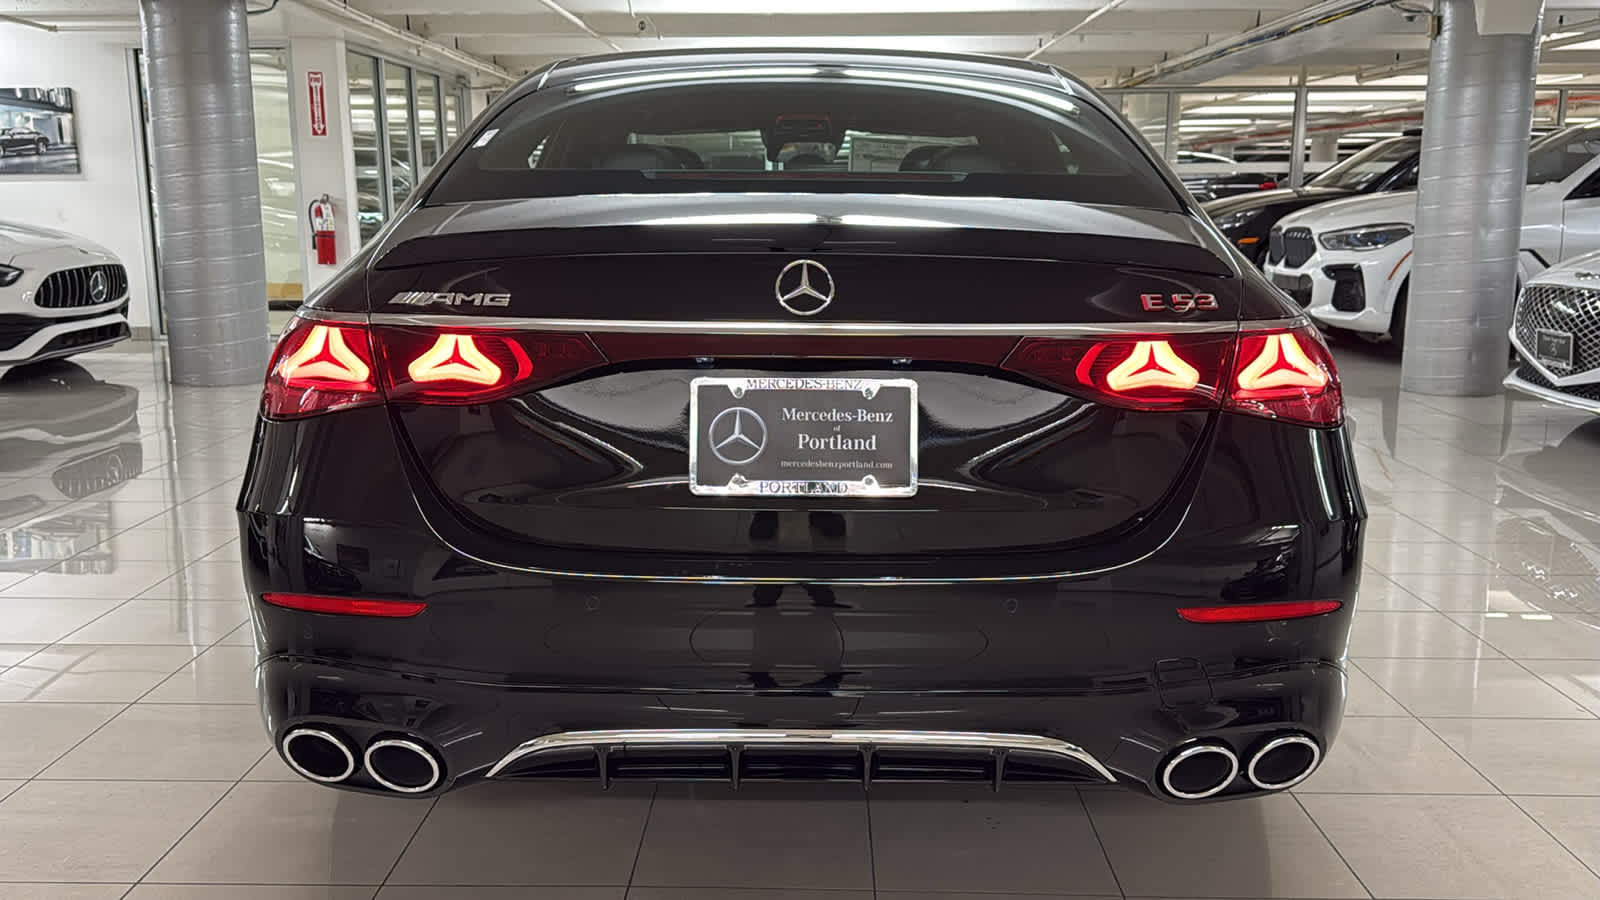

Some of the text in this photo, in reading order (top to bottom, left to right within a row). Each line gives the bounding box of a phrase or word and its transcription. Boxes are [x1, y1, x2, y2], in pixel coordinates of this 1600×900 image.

[1141, 293, 1219, 312] E 53
[747, 379, 863, 390] MERCEDES-BENZ
[782, 407, 893, 422] Mercedes-Benz
[798, 433, 877, 450] Portland
[759, 481, 848, 494] PORTLAND
